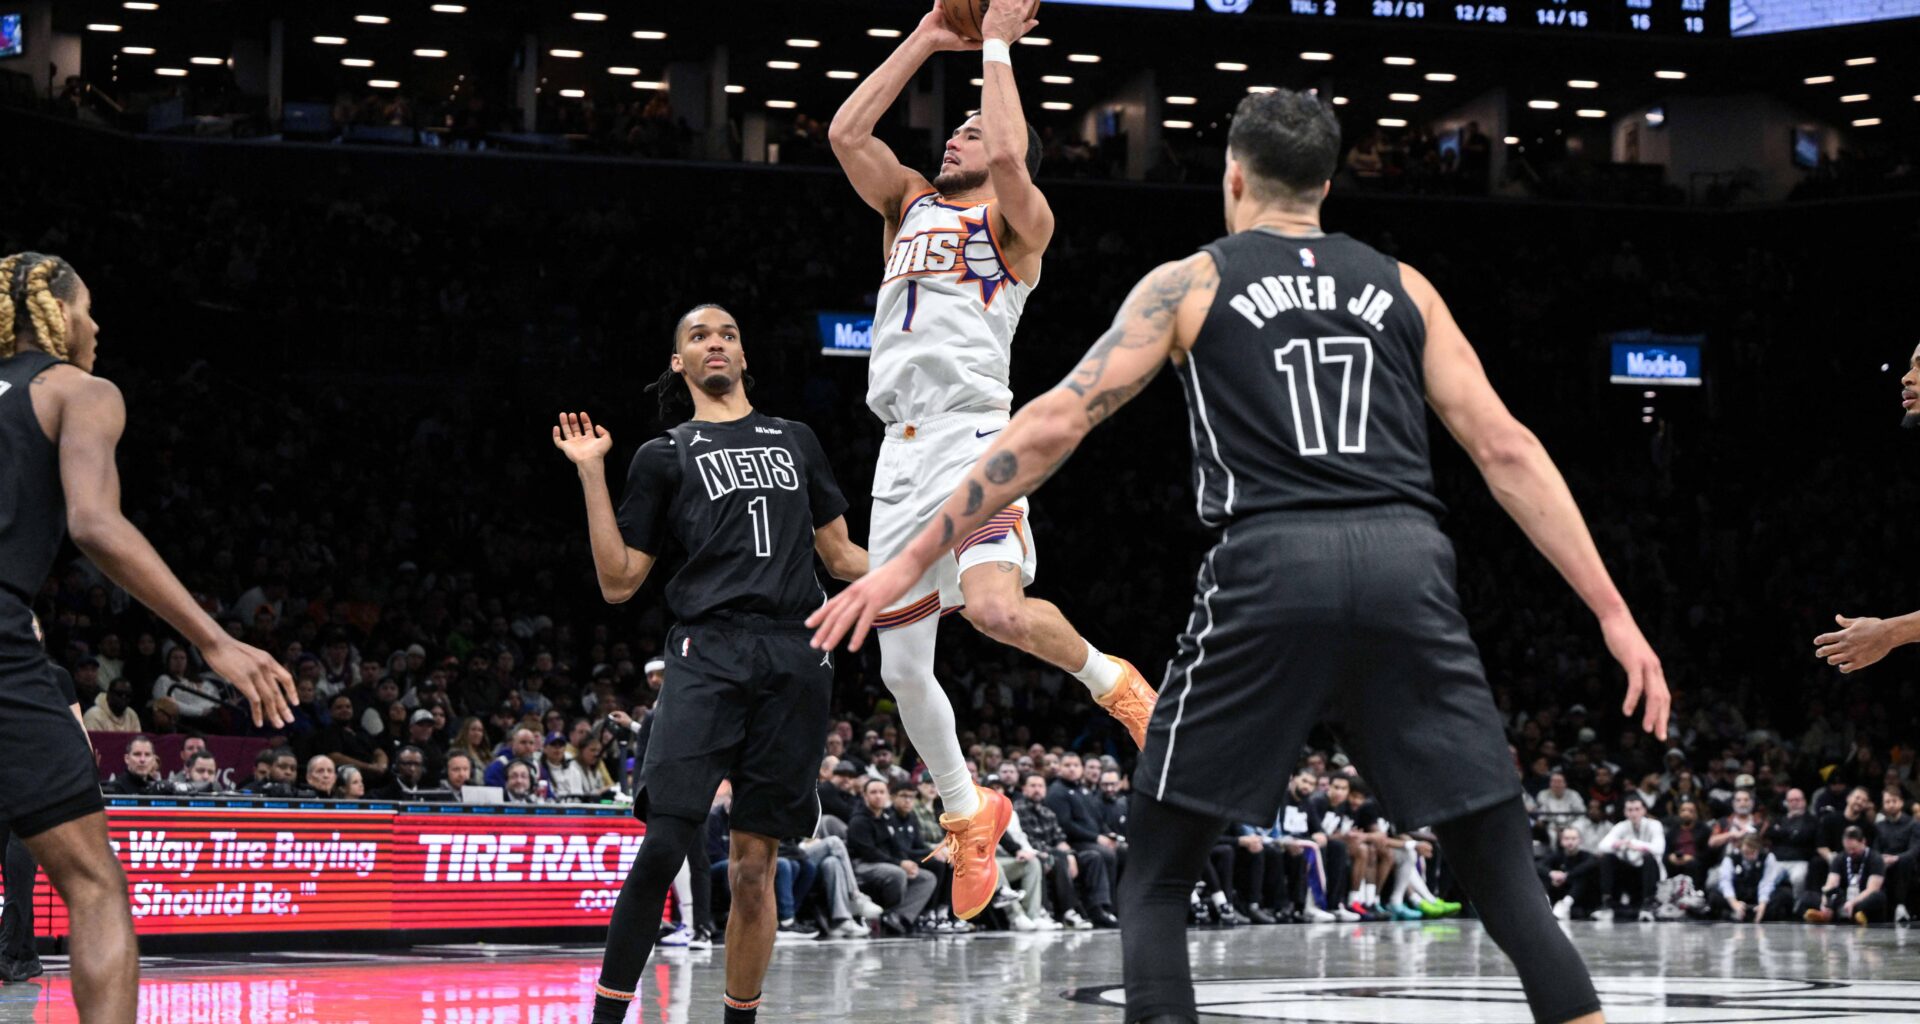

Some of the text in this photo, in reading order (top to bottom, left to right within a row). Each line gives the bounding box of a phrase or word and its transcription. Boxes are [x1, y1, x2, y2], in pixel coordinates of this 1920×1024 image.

[1324, 0, 1337, 16] 2
[1631, 14, 1651, 31] 16
[1229, 275, 1394, 332] PORTER JR.
[835, 323, 873, 349] Mod
[1627, 352, 1687, 377] Modelo
[1273, 336, 1374, 456] 17
[695, 447, 799, 501] NETS
[748, 496, 771, 557] 1
[128, 829, 377, 877] Way Tire Buying
[131, 880, 246, 918] Should
